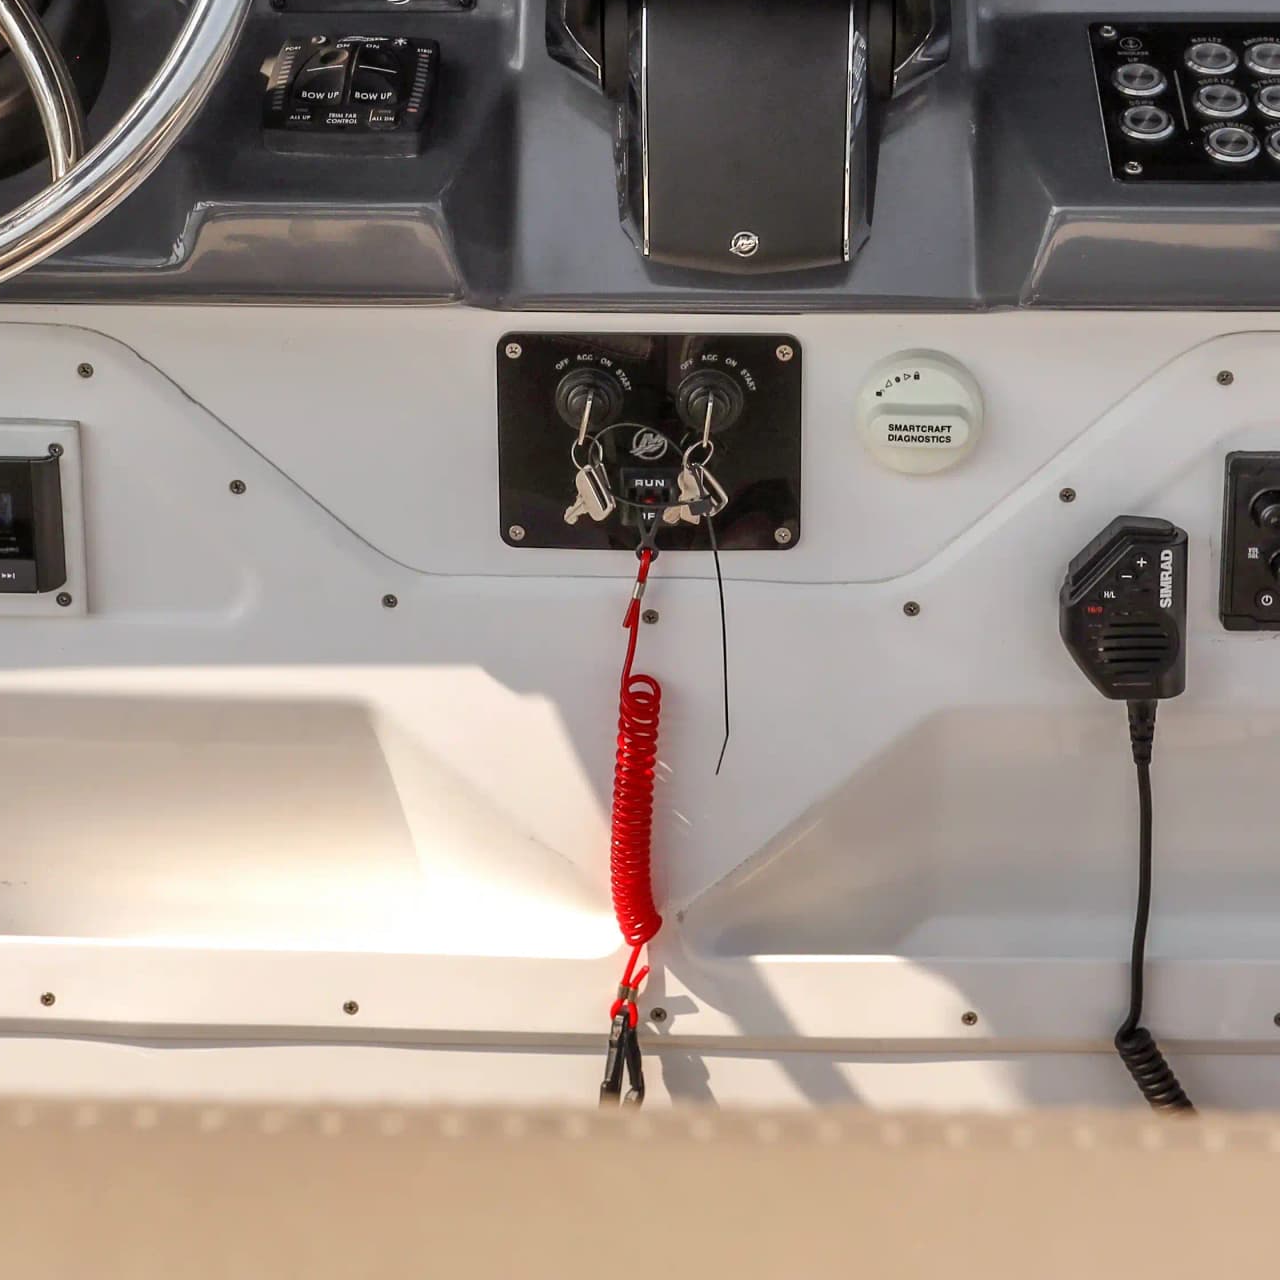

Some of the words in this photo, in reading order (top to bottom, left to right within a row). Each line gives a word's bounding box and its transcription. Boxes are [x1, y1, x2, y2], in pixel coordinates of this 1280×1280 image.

[301, 90, 326, 100] BOW
[327, 91, 340, 99] UP
[354, 91, 379, 100] BOW
[380, 91, 393, 100] UP
[576, 353, 593, 361] ACC
[600, 357, 614, 367] ON
[725, 357, 738, 367] ON
[555, 358, 569, 370] OFF
[615, 368, 632, 391] START
[740, 368, 757, 391] START
[888, 423, 952, 433] SMARTCRAFT
[887, 434, 952, 443] DIAGNOSTICS
[634, 479, 665, 487] RUN
[1159, 549, 1173, 609] SIMRAD
